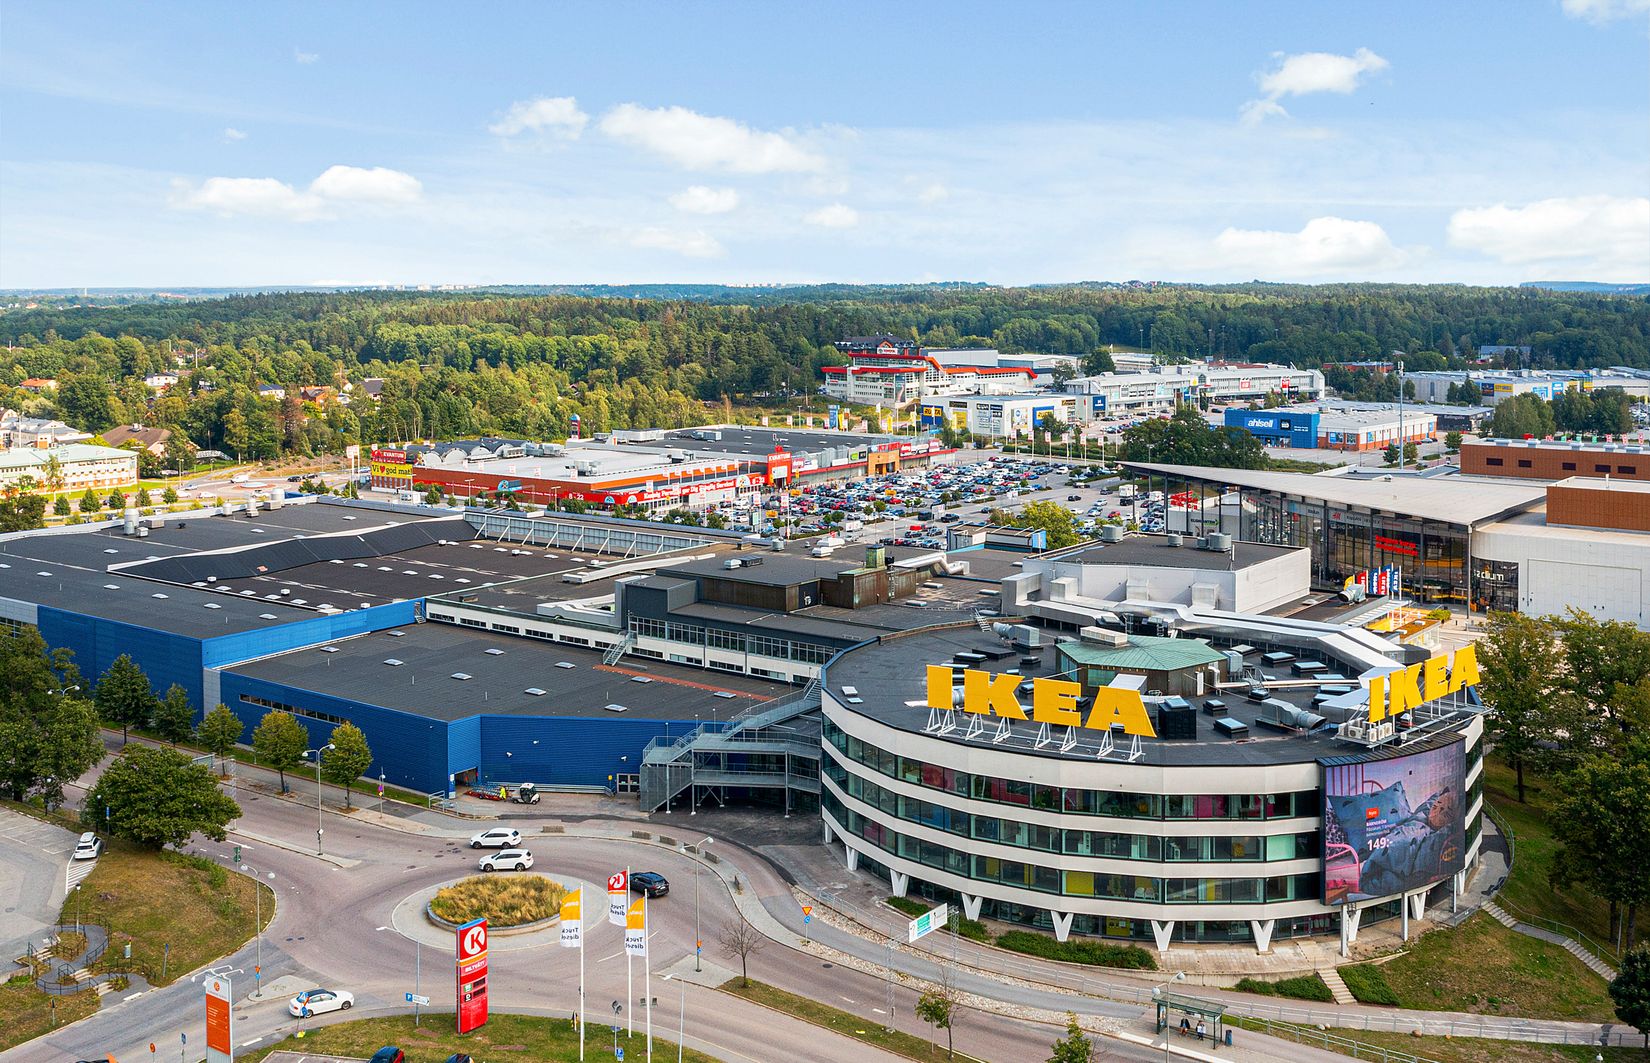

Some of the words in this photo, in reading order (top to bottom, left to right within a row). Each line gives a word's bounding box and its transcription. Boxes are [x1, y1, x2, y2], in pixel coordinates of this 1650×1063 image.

[1248, 419, 1273, 428] ahlsell
[372, 464, 379, 473] Vi
[386, 467, 397, 475] god
[1369, 644, 1481, 723] IKEA
[926, 664, 1157, 738] IKEA
[1367, 837, 1393, 851] 149:-
